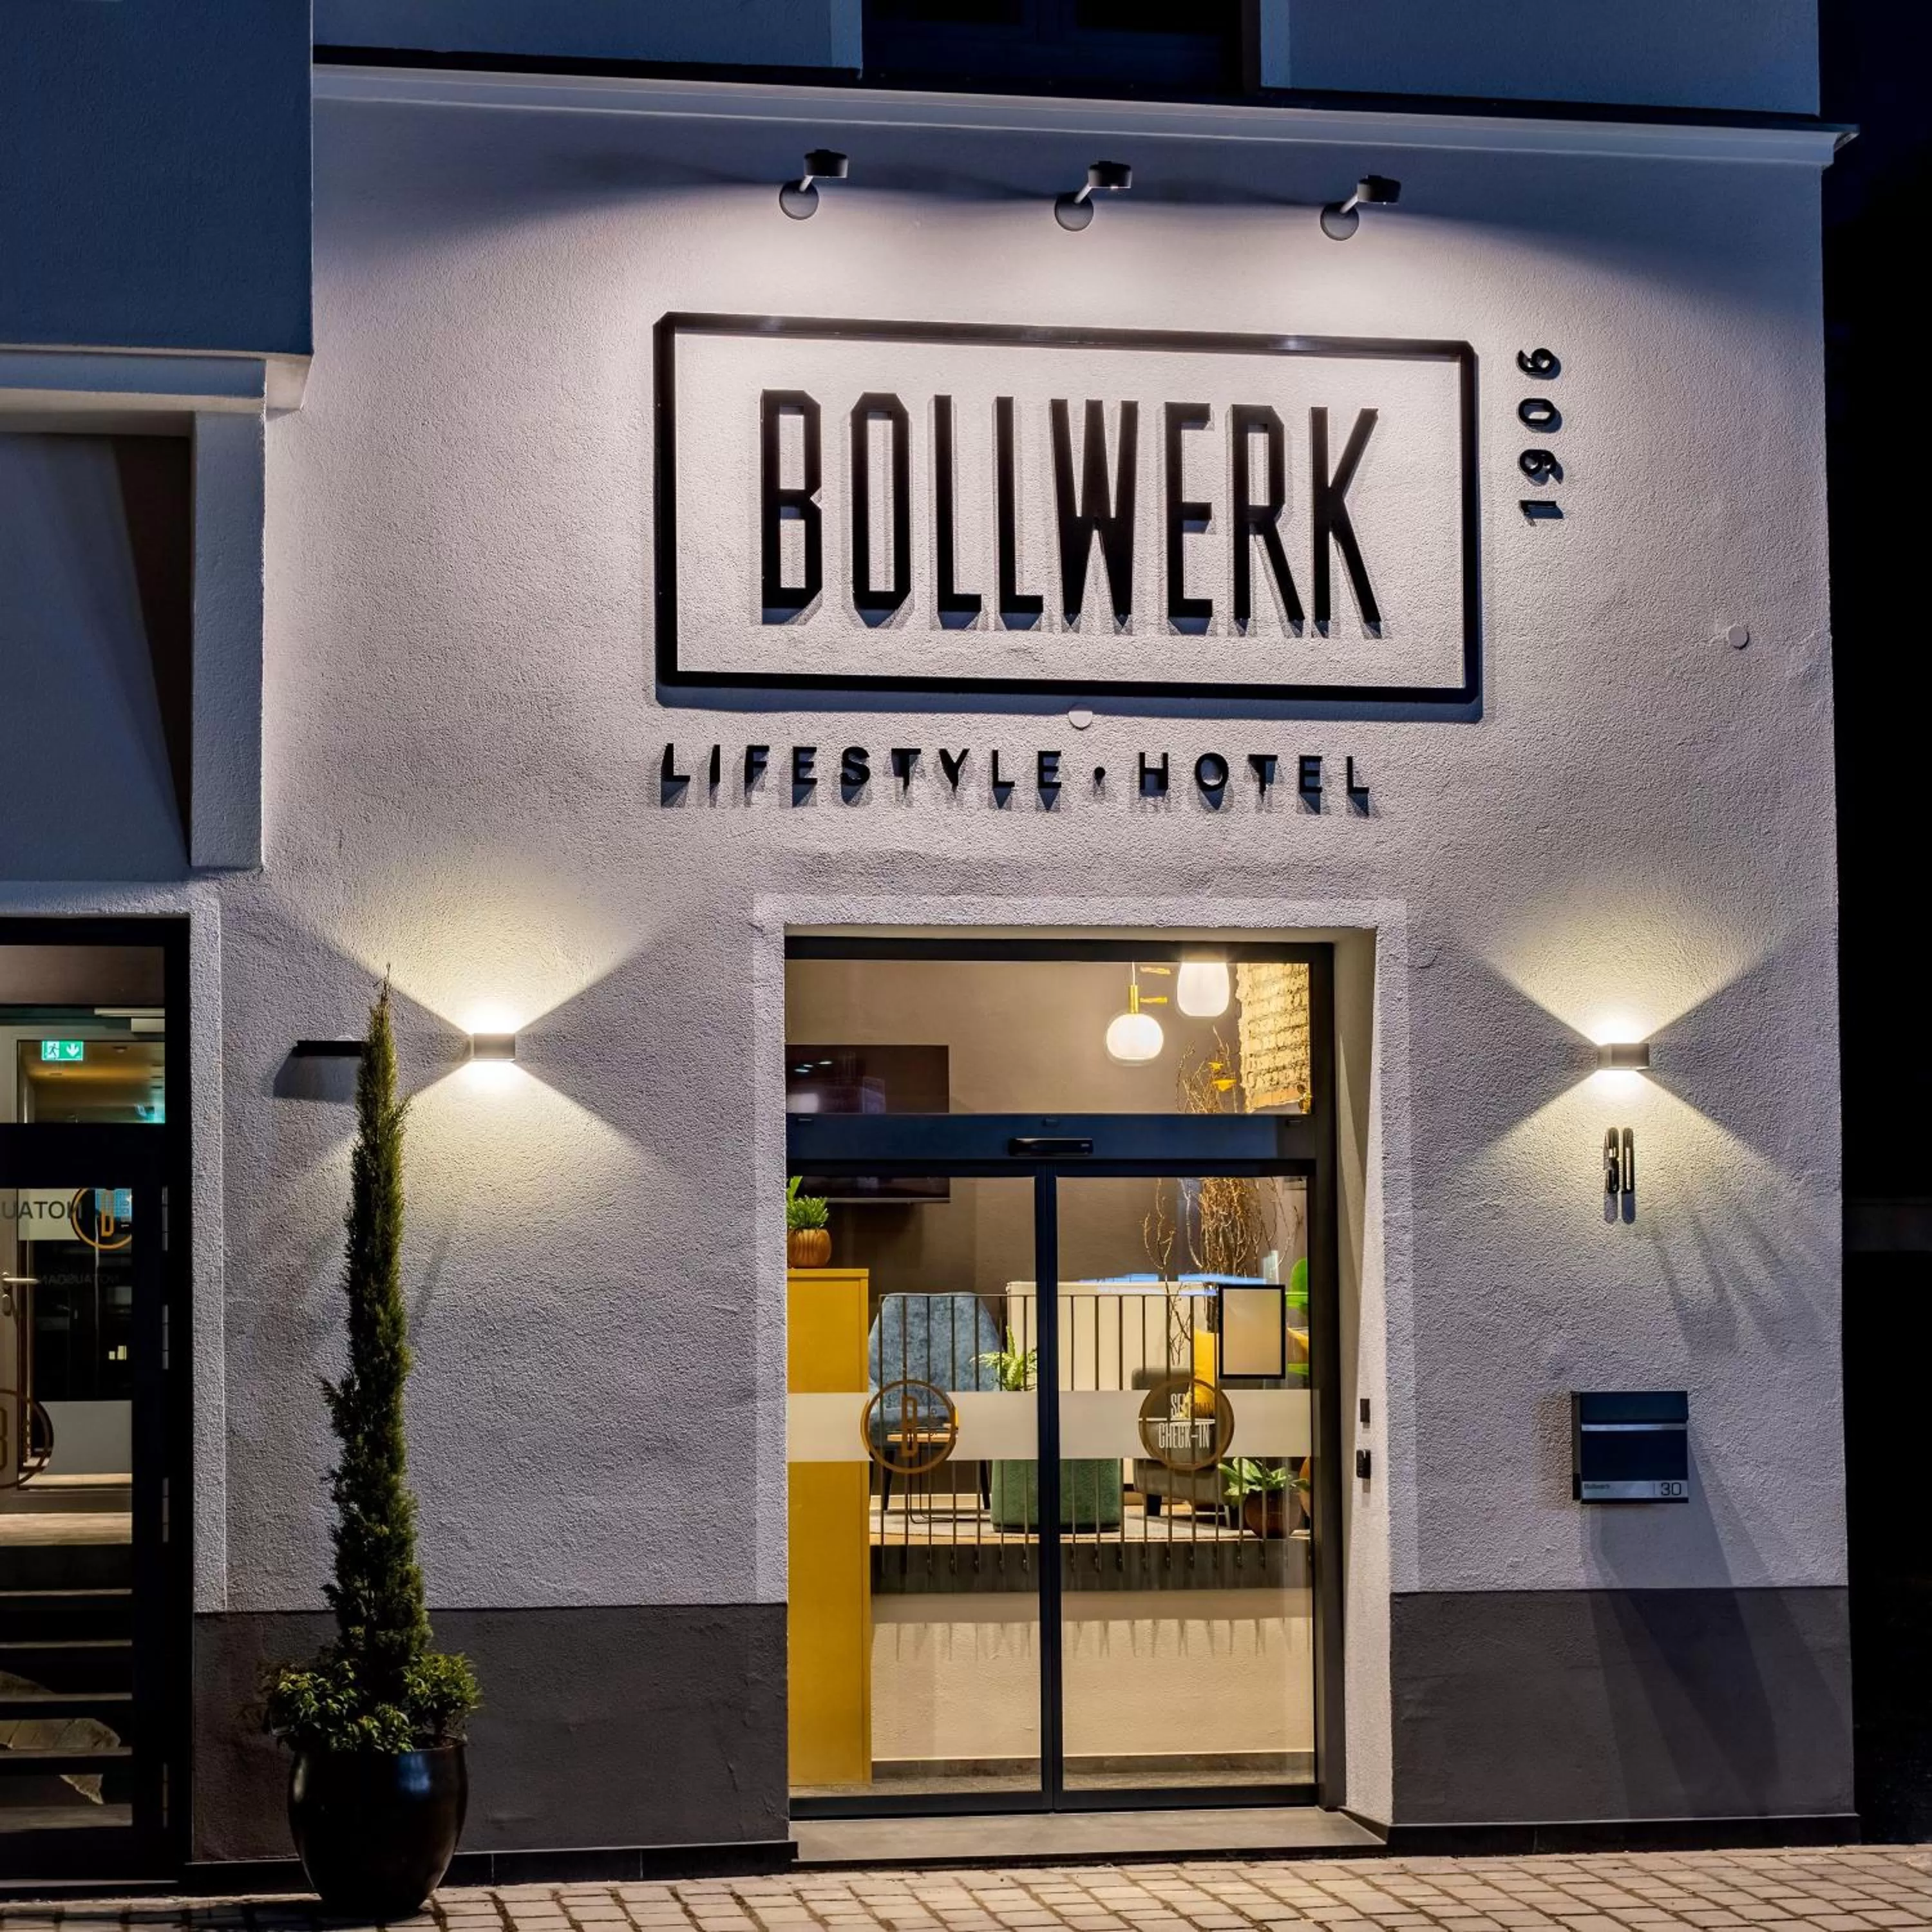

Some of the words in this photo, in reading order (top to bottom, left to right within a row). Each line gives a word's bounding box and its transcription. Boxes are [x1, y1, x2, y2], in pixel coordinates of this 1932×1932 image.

[1516, 347, 1559, 520] 1906
[761, 388, 1382, 623] BOLLWERK
[660, 742, 1063, 795] LIFESTYLE
[1139, 752, 1370, 799] HOTEL
[1604, 1128, 1635, 1195] 30
[1159, 1423, 1211, 1448] CHECK-IN
[1660, 1482, 1682, 1496] 30
